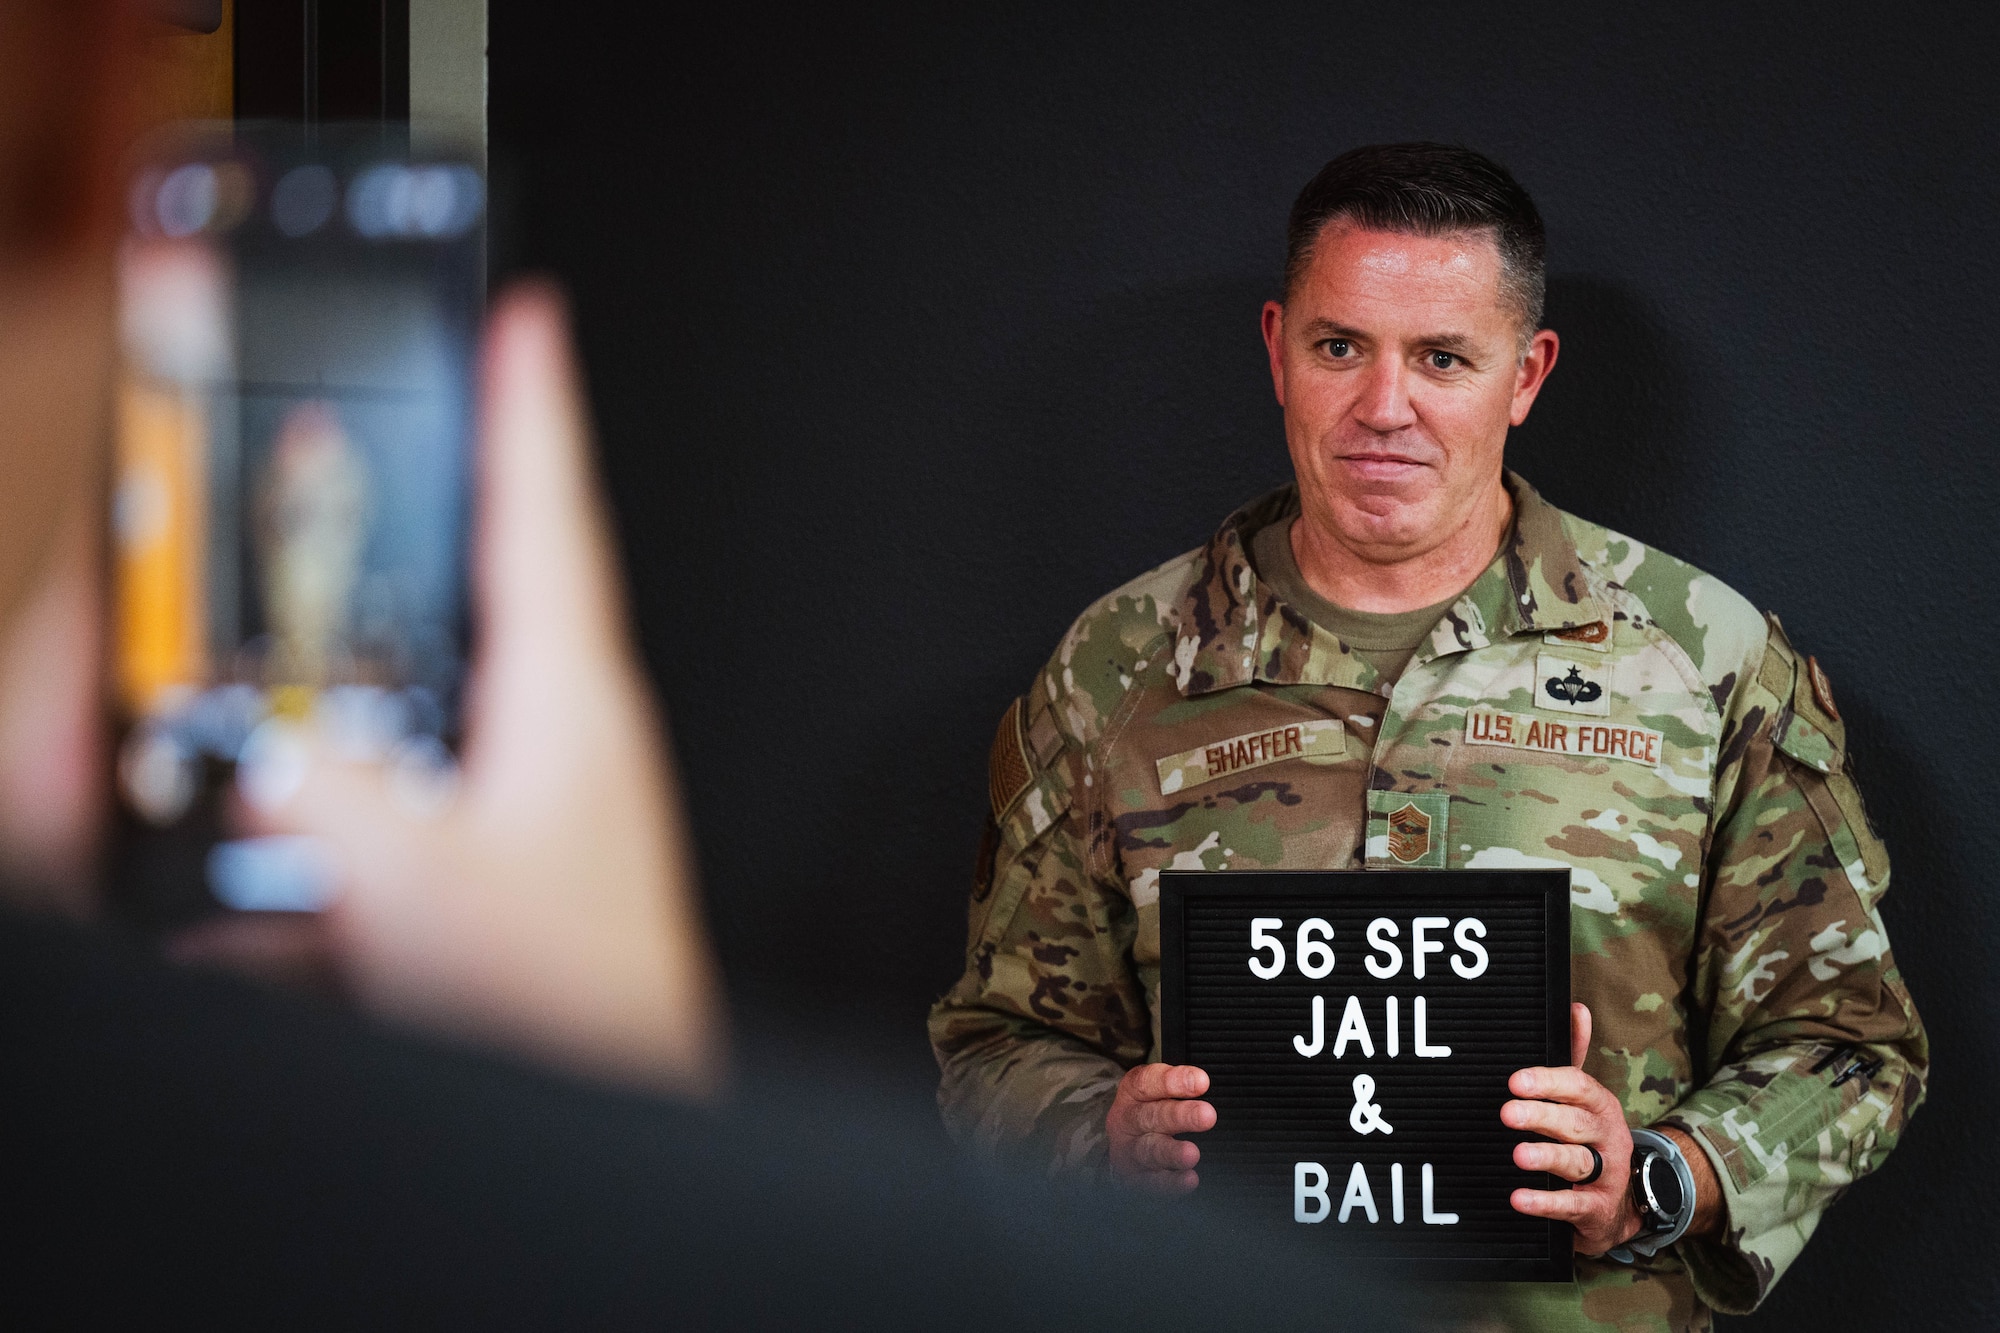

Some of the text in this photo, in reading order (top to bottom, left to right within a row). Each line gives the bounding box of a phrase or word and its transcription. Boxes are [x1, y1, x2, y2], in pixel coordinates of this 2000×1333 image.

[1205, 727, 1301, 777] SHAFFER
[1472, 713, 1658, 763] U.S. AIR FORCE
[1248, 917, 1489, 980] 56 SFS
[1293, 995, 1452, 1058] JAIL
[1349, 1073, 1394, 1135] &
[1293, 1161, 1460, 1225] BAIL
